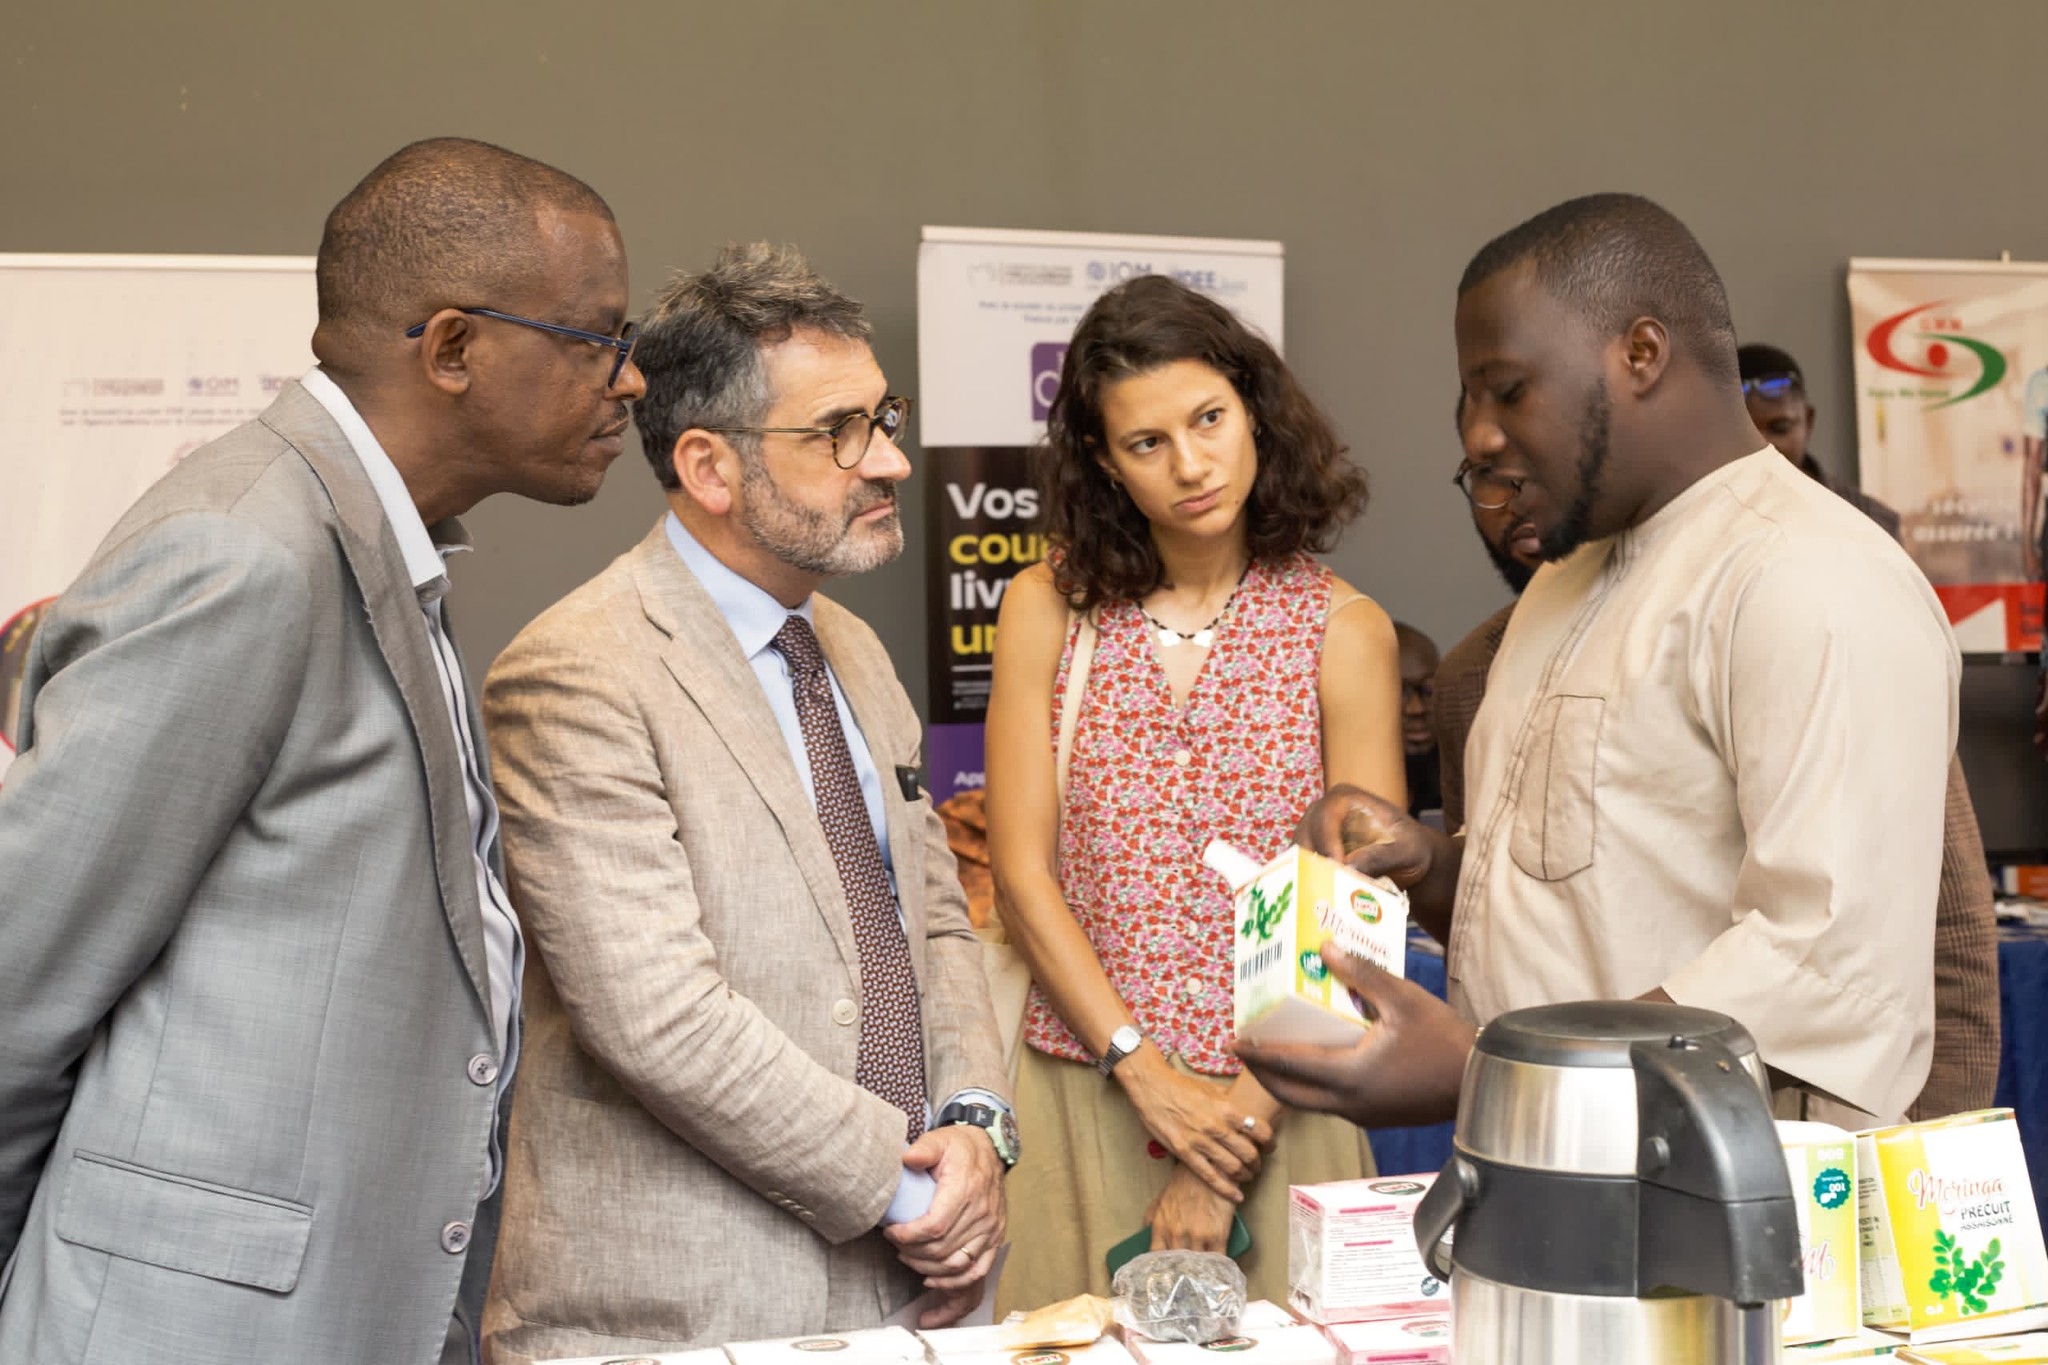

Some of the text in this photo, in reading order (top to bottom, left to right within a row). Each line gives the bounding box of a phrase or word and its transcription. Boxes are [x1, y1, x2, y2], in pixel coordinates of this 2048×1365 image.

[946, 483, 1040, 519] Vos
[951, 570, 1011, 611] liv
[1909, 1170, 2005, 1210] Moringa
